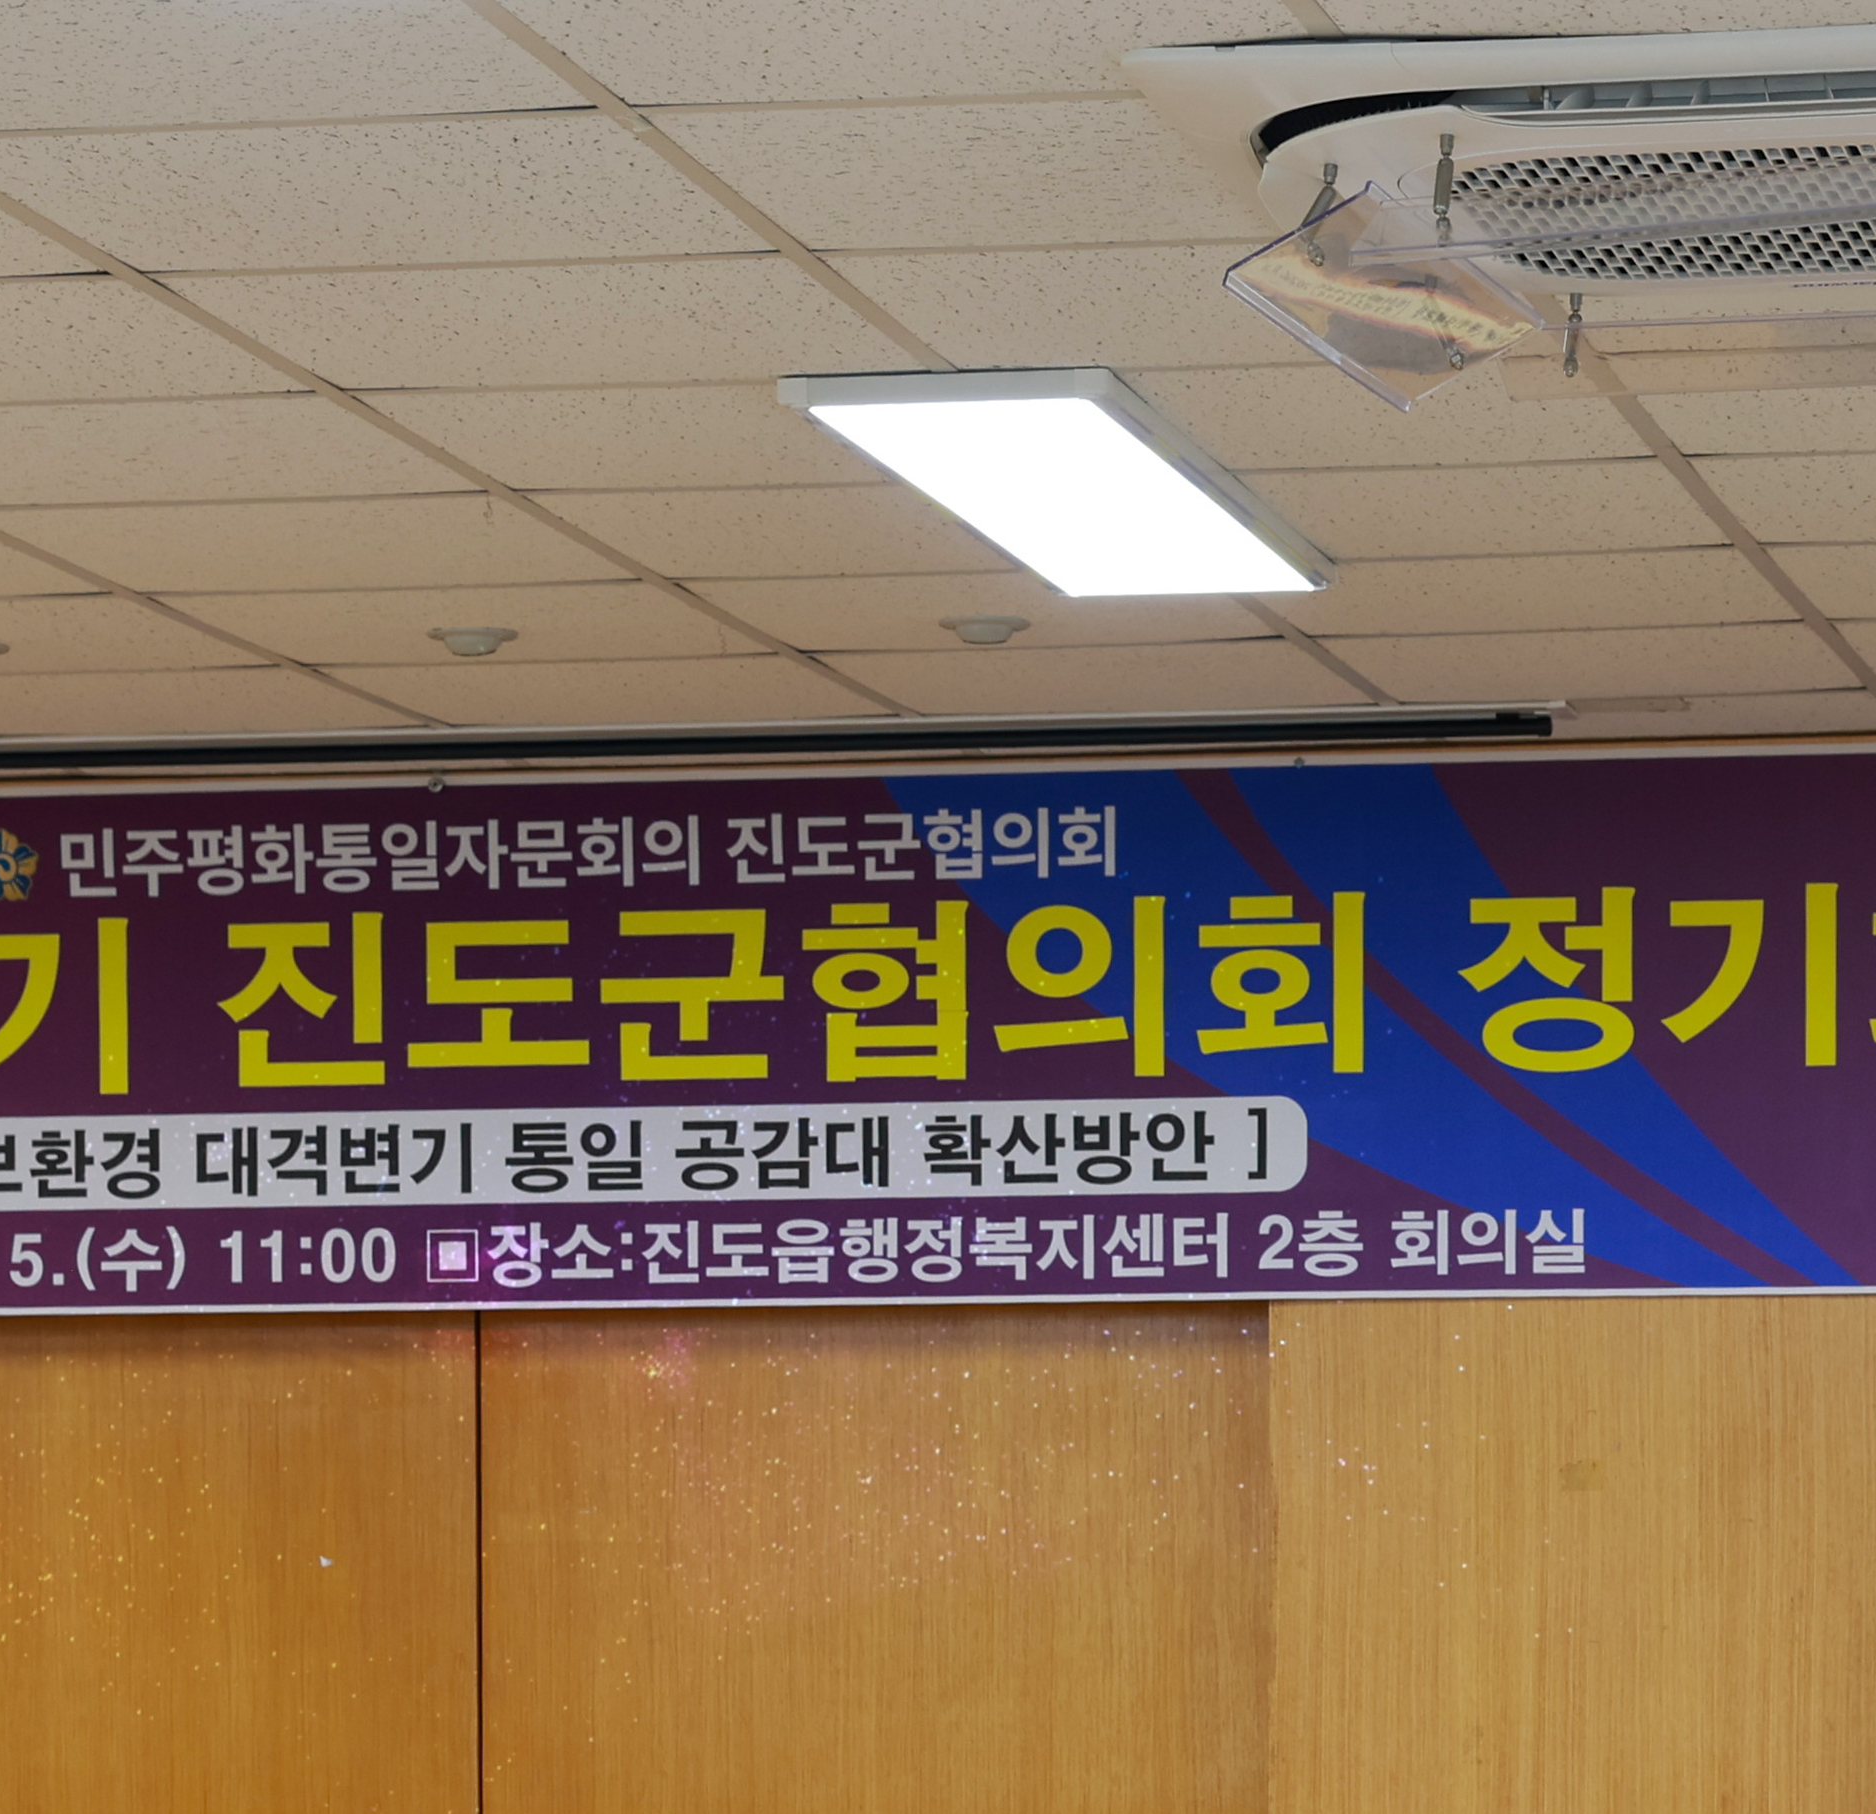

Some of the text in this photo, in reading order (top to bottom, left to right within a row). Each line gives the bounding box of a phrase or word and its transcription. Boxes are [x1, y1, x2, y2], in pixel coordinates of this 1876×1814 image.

[60, 806, 1117, 897] 민주평화통일자문회의 진도군협의회
[217, 891, 1365, 1089] 진도군협의회
[195, 1122, 473, 1198] 대격변기
[504, 1116, 644, 1192] 통일
[673, 1113, 890, 1189] 공감대
[923, 1109, 1216, 1186] 확산방안
[9, 1227, 187, 1294] 5.(수)
[219, 1226, 398, 1286] 11:00
[487, 1206, 1588, 1291] 장소:진도읍행정복지센터 2층 회의실
